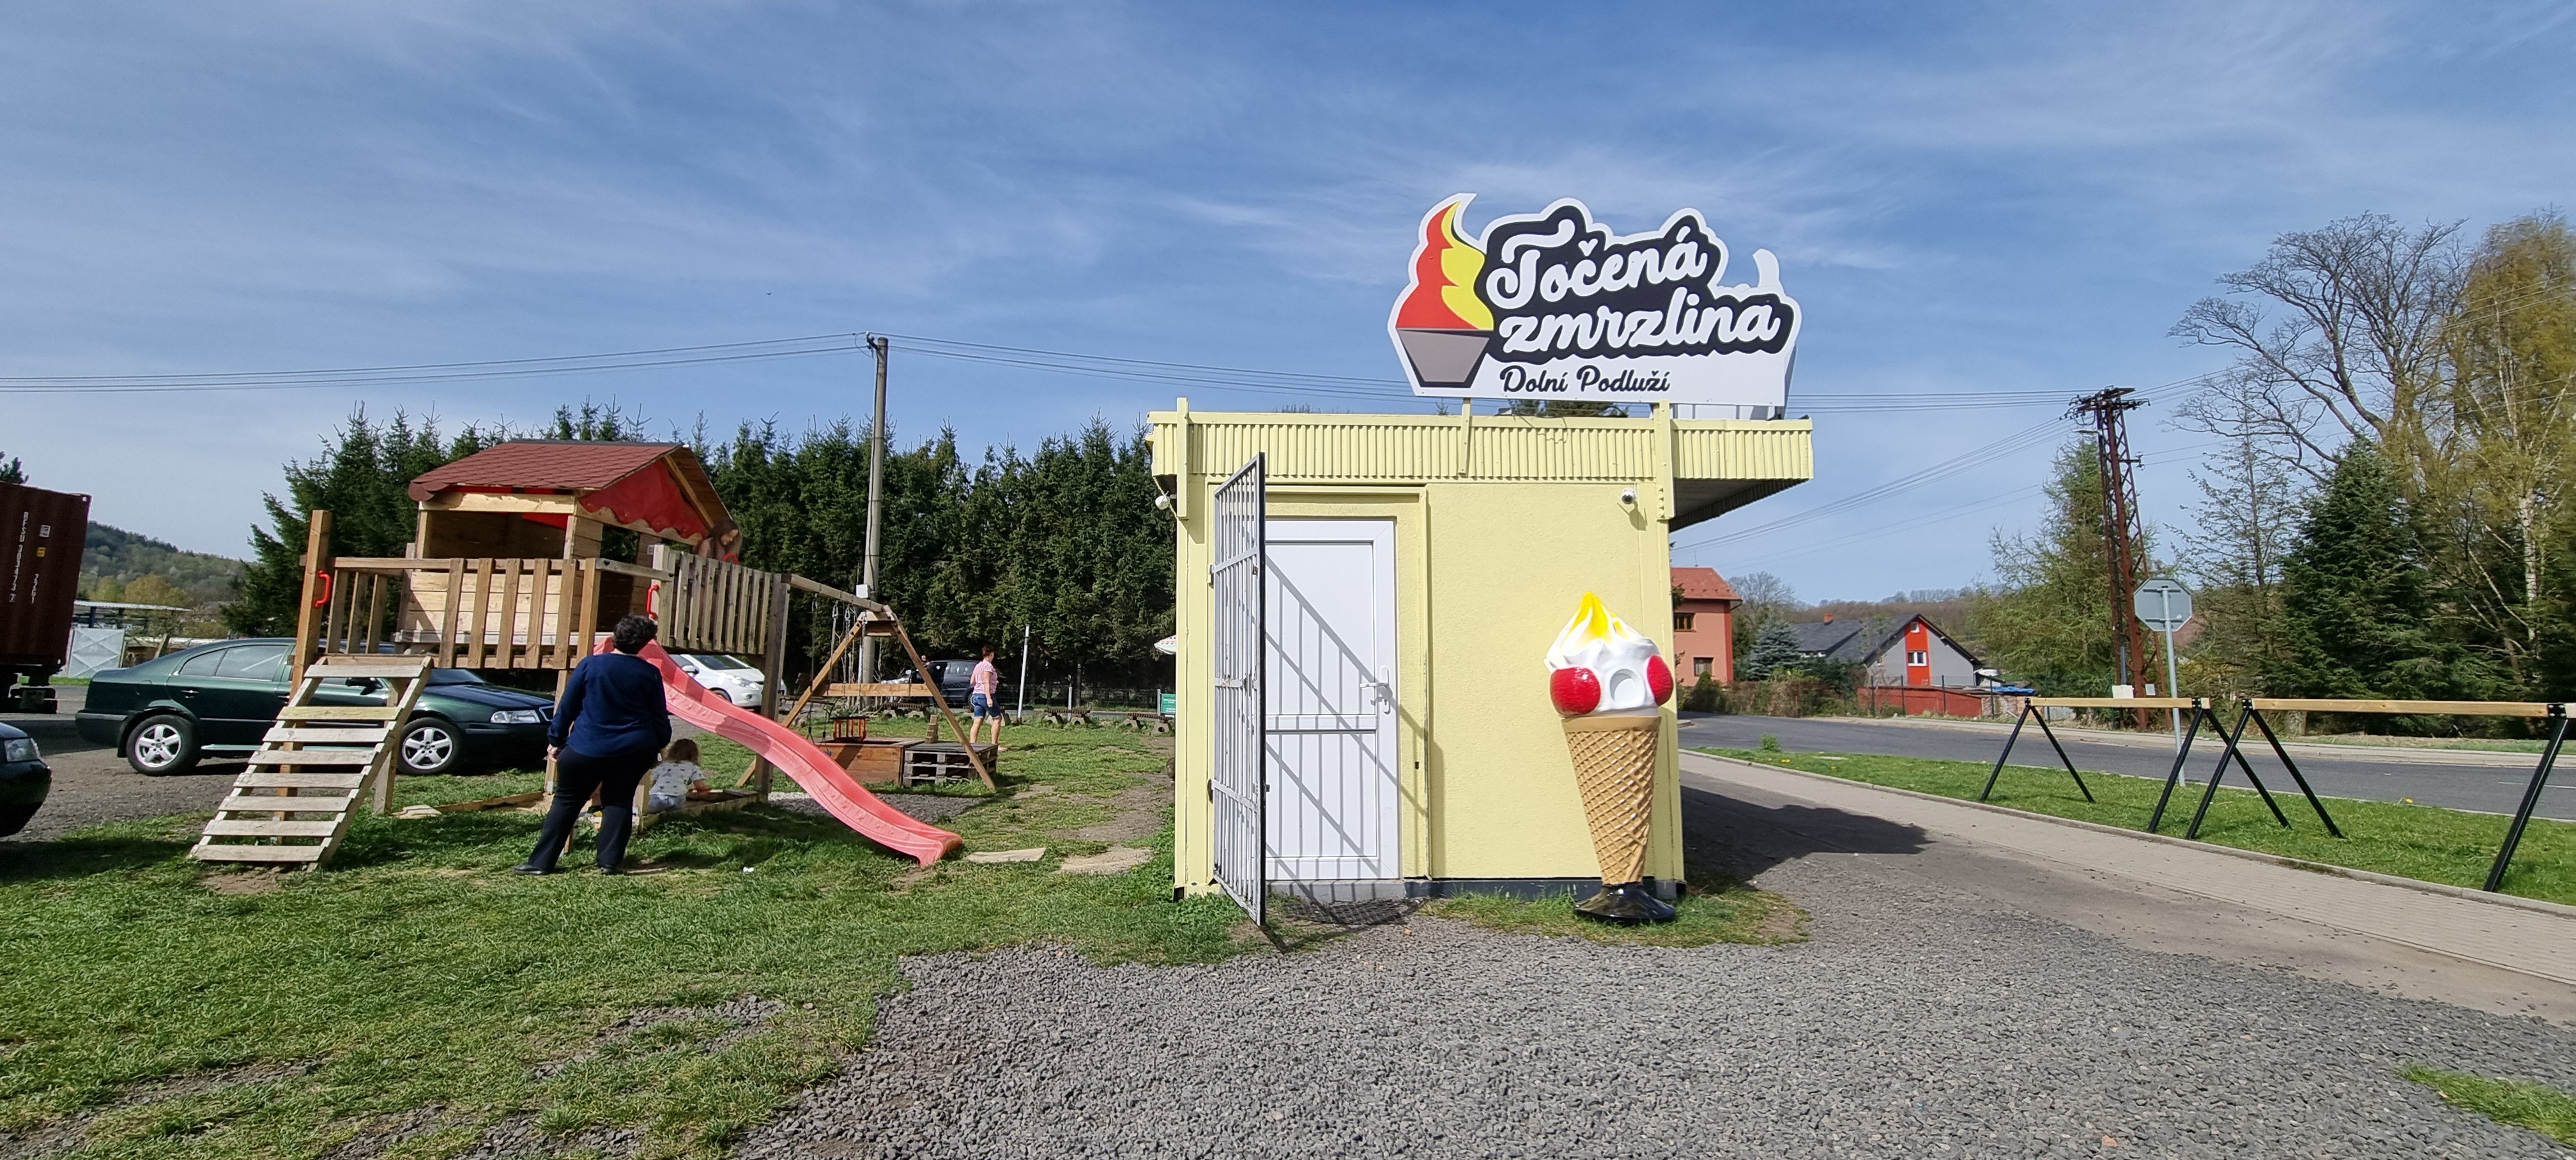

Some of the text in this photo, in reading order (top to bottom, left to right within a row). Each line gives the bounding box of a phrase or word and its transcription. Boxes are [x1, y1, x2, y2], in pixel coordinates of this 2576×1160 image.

[1485, 218, 1707, 309] Točená
[1498, 287, 1781, 353] zmrzlina
[1499, 365, 1670, 392] Dolní Podluží
